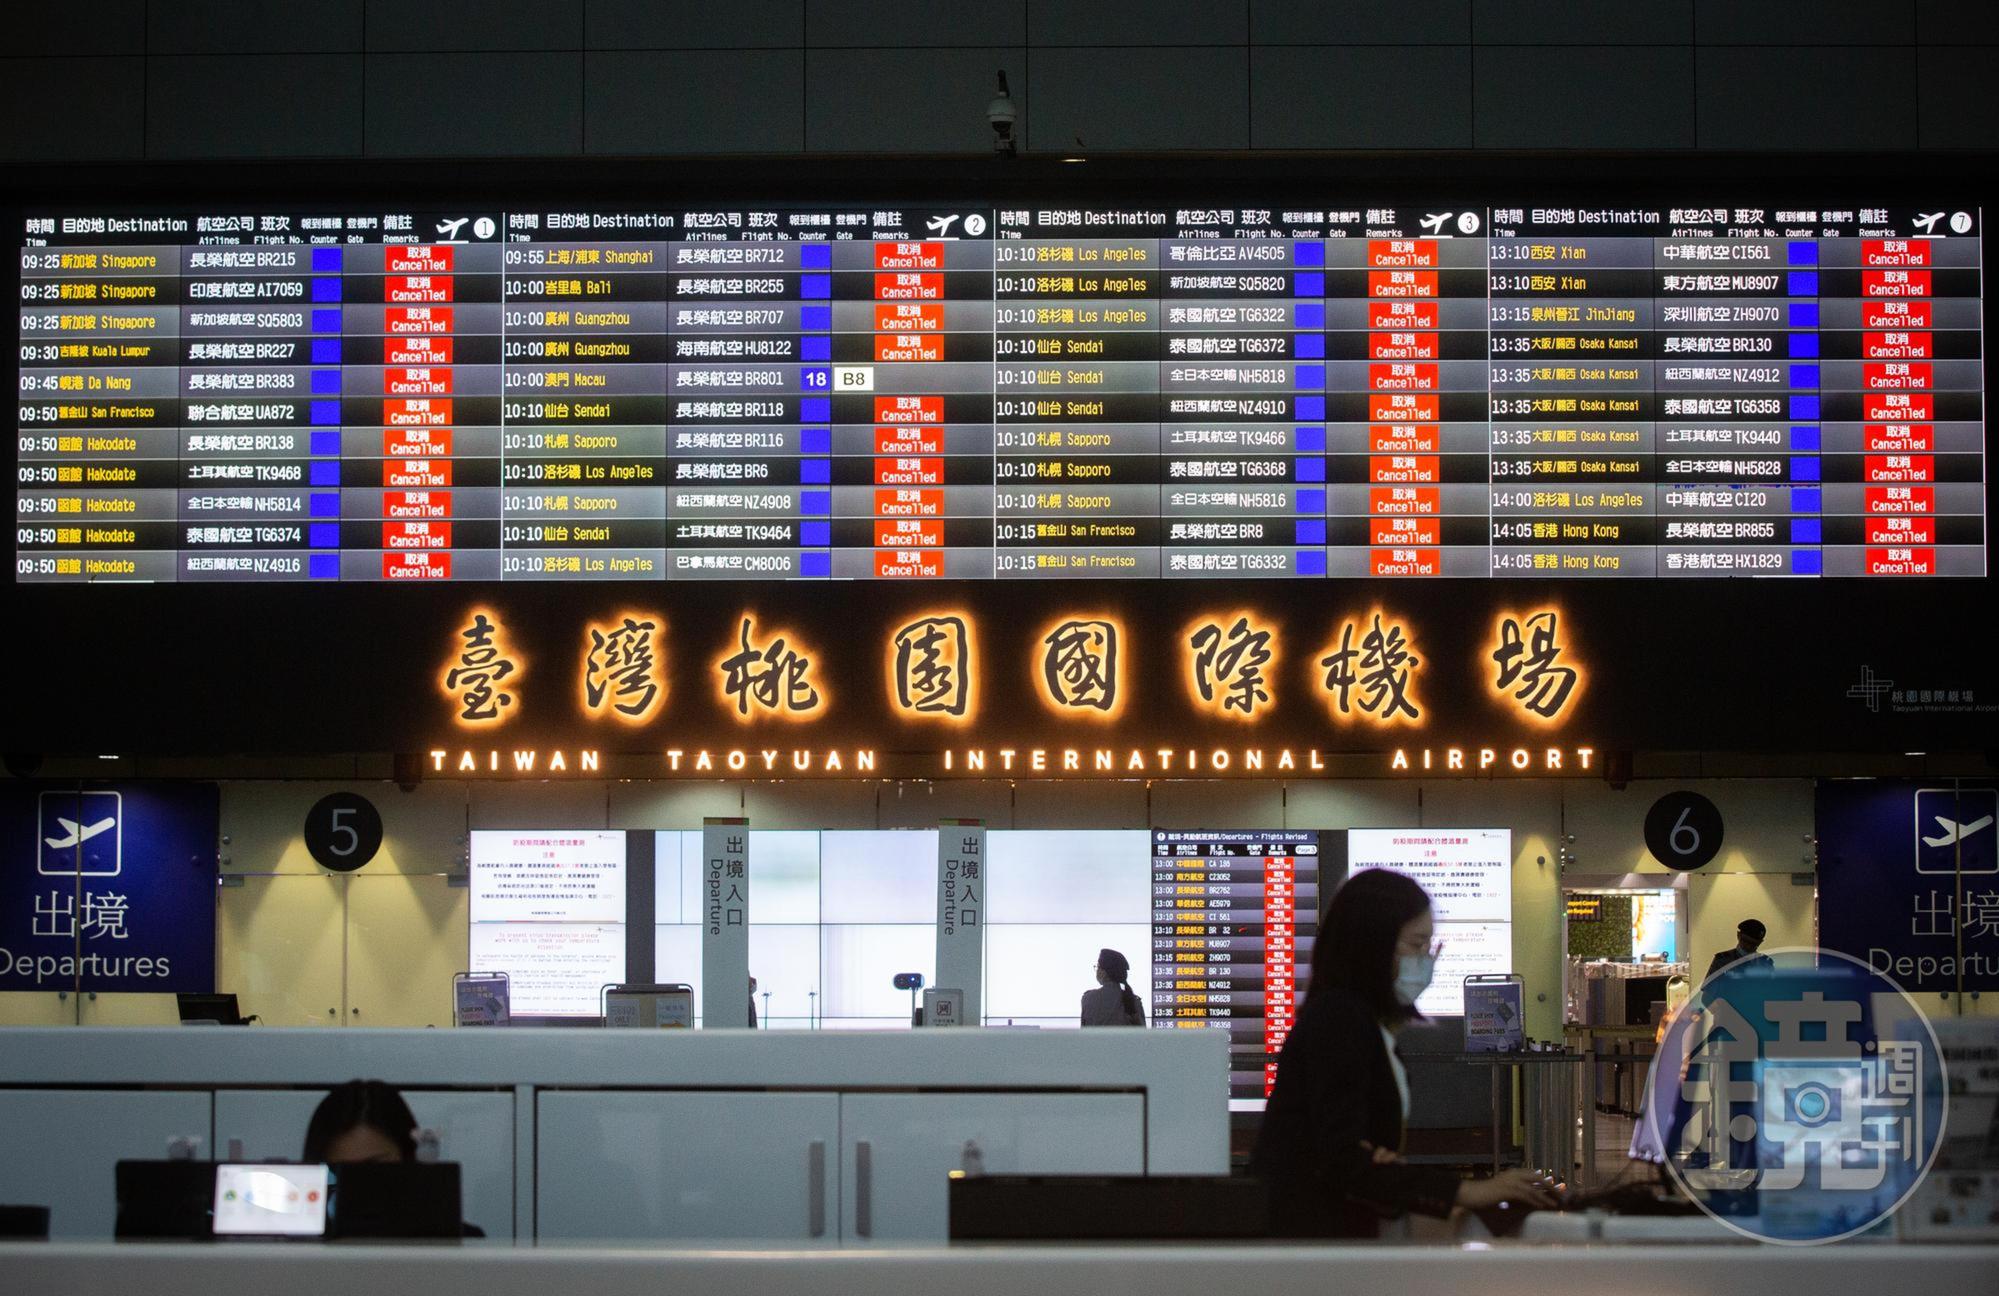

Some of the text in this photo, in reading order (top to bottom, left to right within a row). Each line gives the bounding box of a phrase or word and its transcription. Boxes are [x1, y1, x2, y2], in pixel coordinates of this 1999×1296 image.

[1495, 209, 1523, 224] 時間
[1532, 209, 1575, 223] 目的地
[1579, 210, 1659, 223] Destination
[1670, 209, 1727, 223] 航空公司
[1735, 209, 1764, 223] 班次
[1859, 209, 1888, 223] 備註
[26, 219, 54, 233] 時間
[63, 218, 105, 233] 目的地
[108, 218, 187, 232] Destination
[197, 217, 254, 231] 航空公司
[261, 216, 289, 231] 班次
[383, 215, 412, 230] 備註
[1495, 229, 1895, 237] Time Airlines Flight No. Counter Gate Remarks
[26, 235, 419, 246] Time Airlines Flight No. Counter Gate Remarks
[1391, 241, 1414, 252] 取消
[897, 243, 921, 254] 取消
[995, 248, 1035, 261] 10:10
[1038, 248, 1073, 261] 洛杉磯
[1104, 251, 1143, 260] Angeles
[1170, 246, 1236, 261] 哥倫比亞
[1239, 247, 1284, 260] AV4505
[506, 249, 783, 264] 09:55 上海/浦東 Shanghai 長榮航空 BR712
[882, 256, 936, 267] Cancelled
[1376, 252, 1429, 265] Cancelled
[407, 277, 430, 288] 取消
[22, 283, 302, 298] 09:25 新加坡 Singapore 印度航空 AI7059
[392, 290, 445, 301] Cancelled
[1490, 307, 1778, 321] 13:15 泉州晉江 JinJiang 深圳航空 ZH9070
[1885, 303, 1908, 312] 取消
[1870, 312, 1923, 325] Cancelled
[406, 369, 430, 380] 取消
[503, 371, 865, 386] 10:00 澳門 Macau 長榮航空 BR801 18 B8
[21, 376, 58, 389] 09:45
[88, 376, 101, 389] Da
[106, 377, 131, 389] Nang
[189, 374, 254, 389] 長榮航空
[257, 374, 294, 388] BR383
[392, 382, 445, 393] Cancelled
[1392, 457, 1416, 468] 取消
[995, 462, 1285, 477] 10:10 札幌 Sapporo 泰國航空 TG6368
[1378, 470, 1431, 481] Cancelled
[1888, 518, 1911, 528] 取消
[1491, 523, 1773, 537] 14:05 香港 Hong Kong 長榮航空 BR855
[1873, 529, 1926, 542] Cancelled
[405, 553, 428, 564] 取消
[18, 559, 55, 573] 09:50
[57, 559, 81, 573] 函館
[86, 560, 135, 573] Hakodate
[255, 559, 300, 572] NZ4916
[390, 564, 443, 577] Cancelled
[447, 613, 1577, 720] 臺灣桃園國際機場
[1892, 690, 1975, 703] 桃園國際機場
[1893, 705, 1923, 713] Taoyuan
[1924, 704, 1974, 712] International
[431, 749, 1594, 771] TAIWAN TAOYUAN INTERNATIONAL AIRPORT
[329, 808, 359, 856] 5
[1669, 807, 1700, 855] 6
[726, 836, 744, 926] 出境入口
[961, 837, 979, 927] 出境入口
[1155, 873, 1173, 881] 13:00
[707, 859, 724, 935] Departure
[942, 860, 959, 936] Departure
[32, 890, 129, 940] 出境
[1155, 913, 1173, 921] 13:10
[1912, 889, 1999, 938] 出境
[1155, 926, 1173, 934] 13:10
[1155, 940, 1173, 948] 13:10
[1155, 953, 1173, 961] 13:15
[1155, 967, 1173, 975] 13:35
[1155, 981, 1173, 989] 13:35
[1155, 995, 1173, 1003] 13:35
[1155, 1008, 1173, 1016] 13:35
